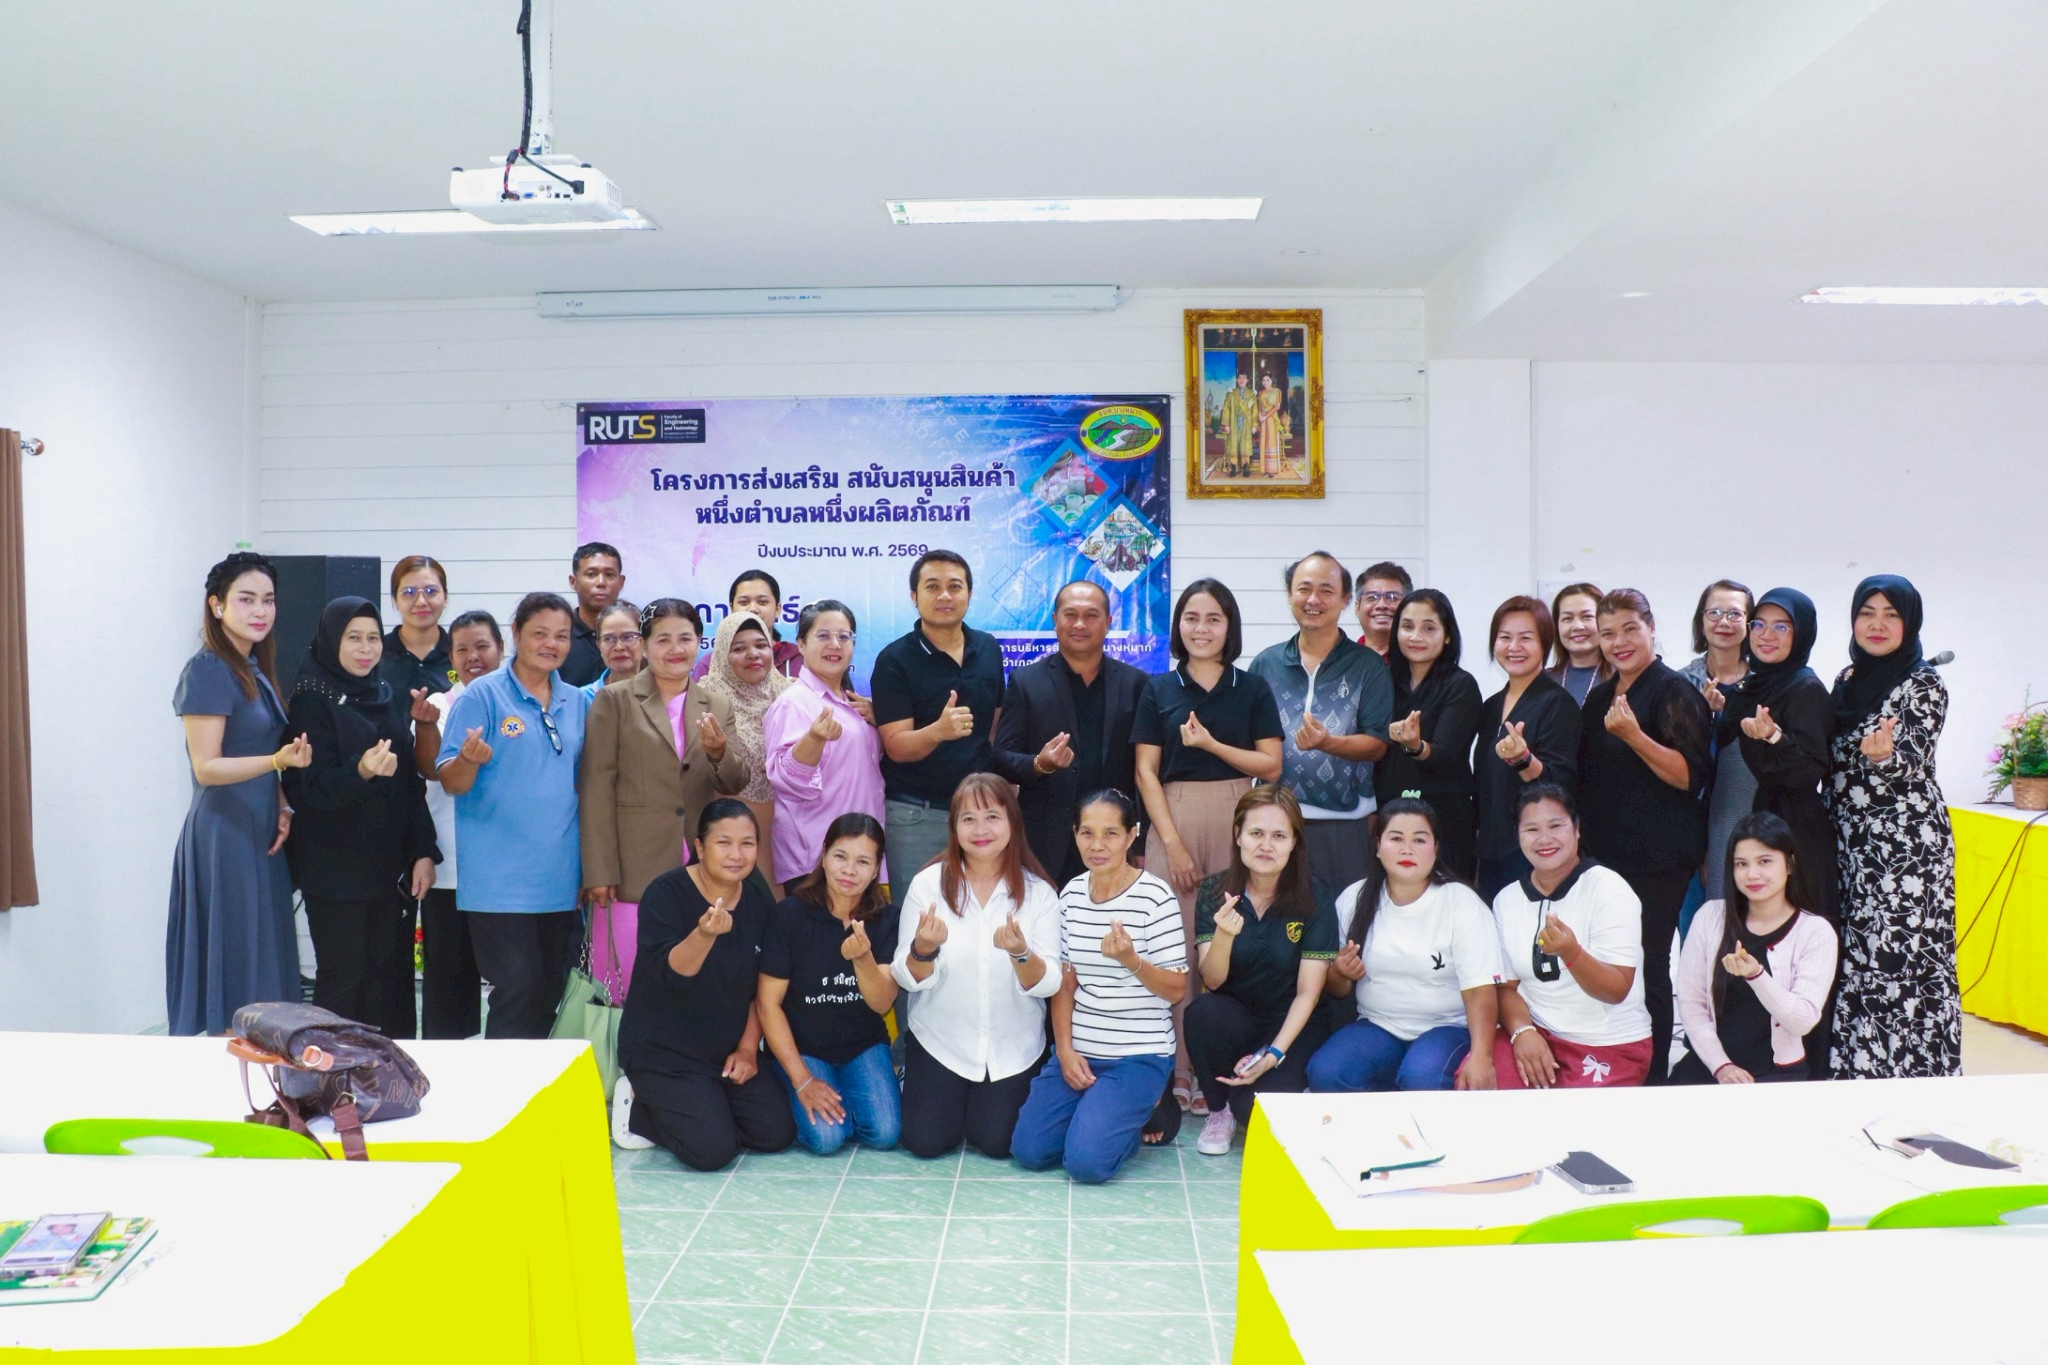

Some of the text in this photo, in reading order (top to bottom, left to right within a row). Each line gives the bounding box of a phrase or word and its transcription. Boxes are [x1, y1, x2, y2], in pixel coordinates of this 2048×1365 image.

[589, 414, 656, 440] RUTS
[650, 461, 1016, 497] โครงการส่งเสริม สนับสนุนสินค้า
[695, 494, 972, 524] หนึ่งตำบลหนึ่งผลิตภัณฑ์
[757, 543, 929, 558] ปีงบประมาณ พ.ศ. 2569
